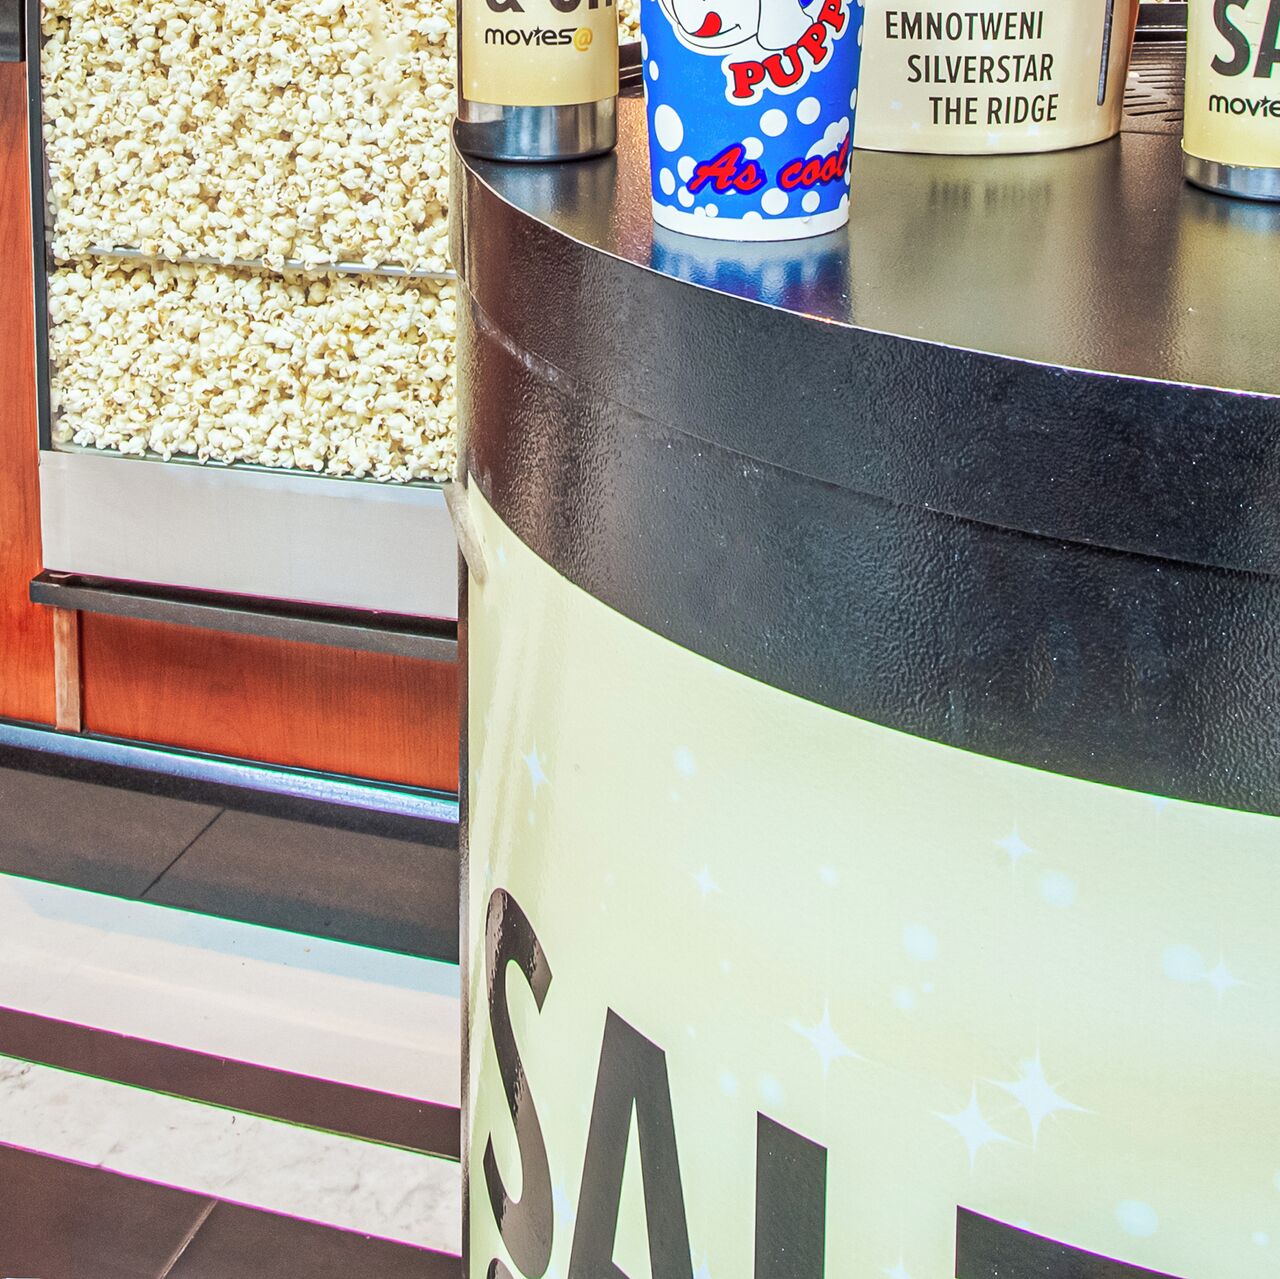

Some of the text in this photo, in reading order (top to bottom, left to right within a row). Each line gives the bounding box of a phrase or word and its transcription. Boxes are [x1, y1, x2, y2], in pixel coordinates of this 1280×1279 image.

[484, 25, 594, 51] movies@
[885, 10, 1044, 41] EMNOTWENI
[907, 52, 1054, 84] SILVERSTAR
[929, 93, 1059, 125] THE RIDGE
[689, 132, 850, 191] As cool
